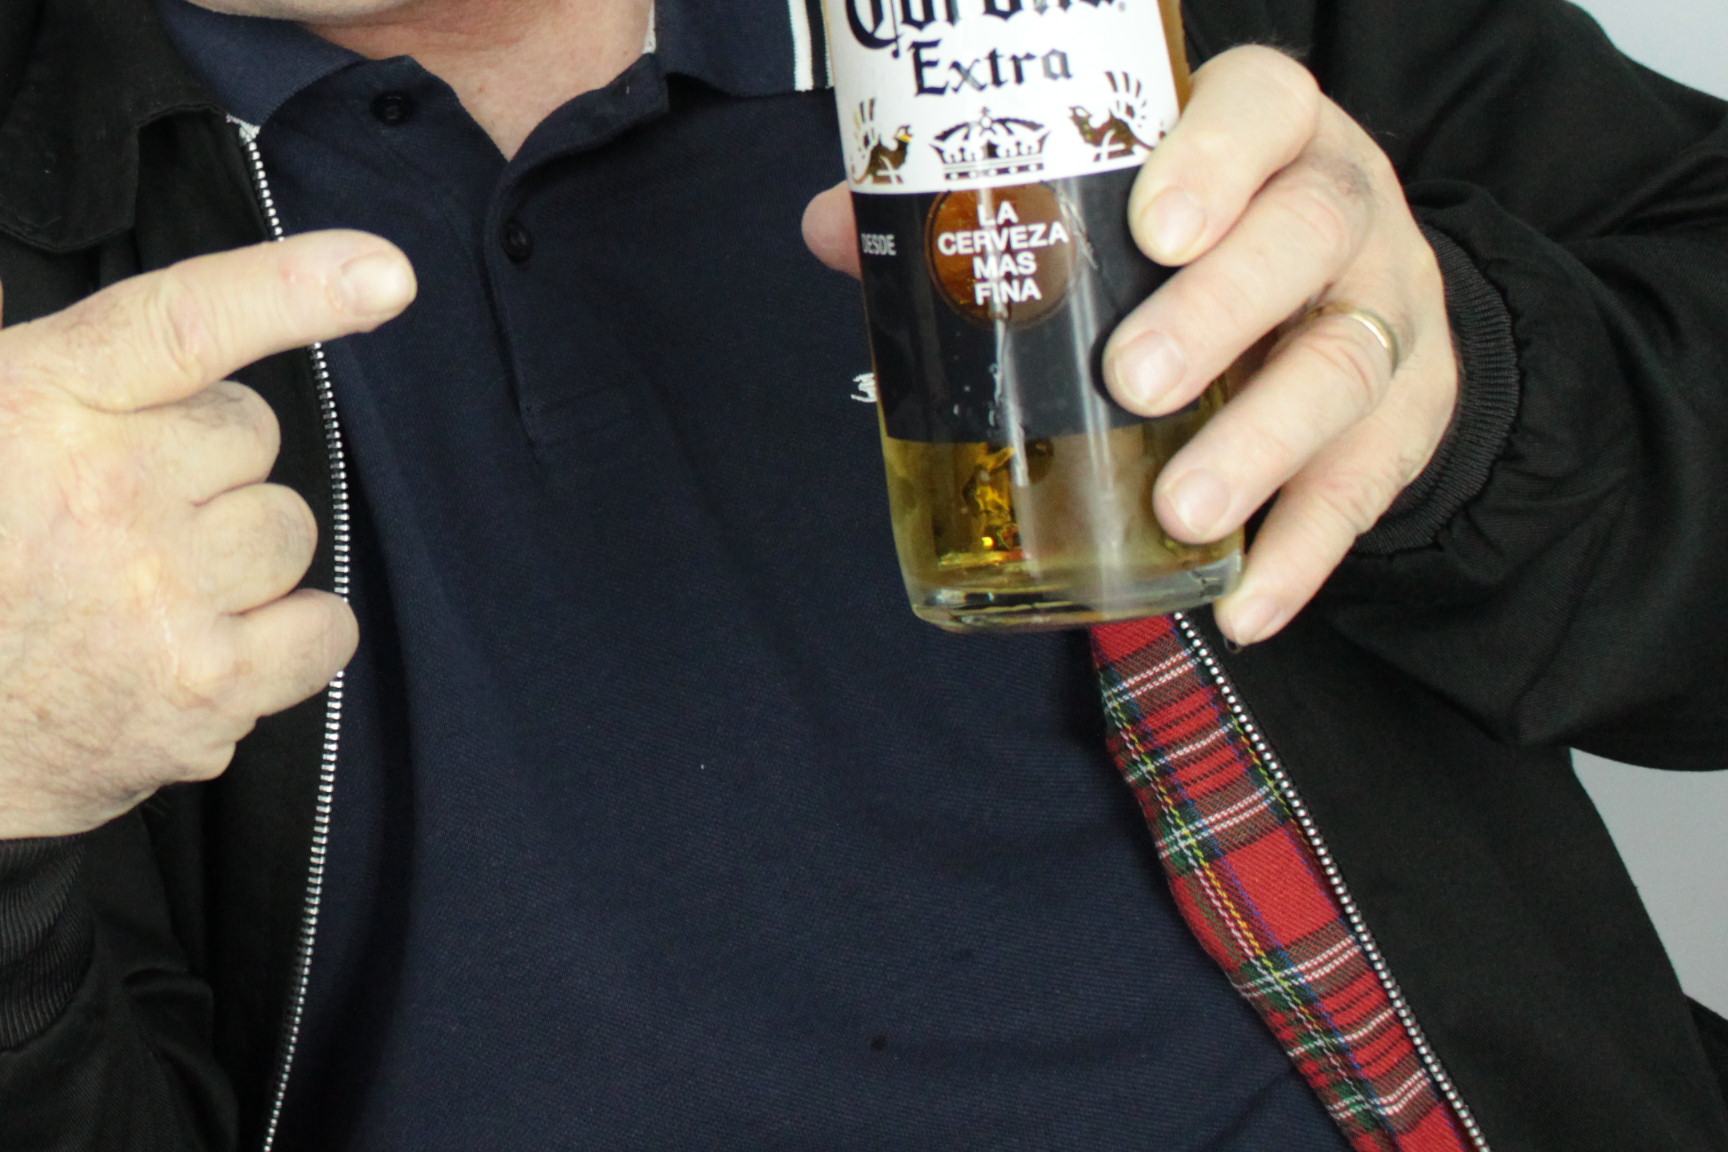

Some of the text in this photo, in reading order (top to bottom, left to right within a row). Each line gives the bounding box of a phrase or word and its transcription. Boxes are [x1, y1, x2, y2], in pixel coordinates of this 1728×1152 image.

[907, 38, 1073, 98] Extra
[977, 200, 1019, 227] LA
[860, 233, 898, 256] DESDE
[937, 220, 1070, 256] CERVEZA
[973, 251, 1038, 279] MAS
[974, 277, 1043, 306] FINA
